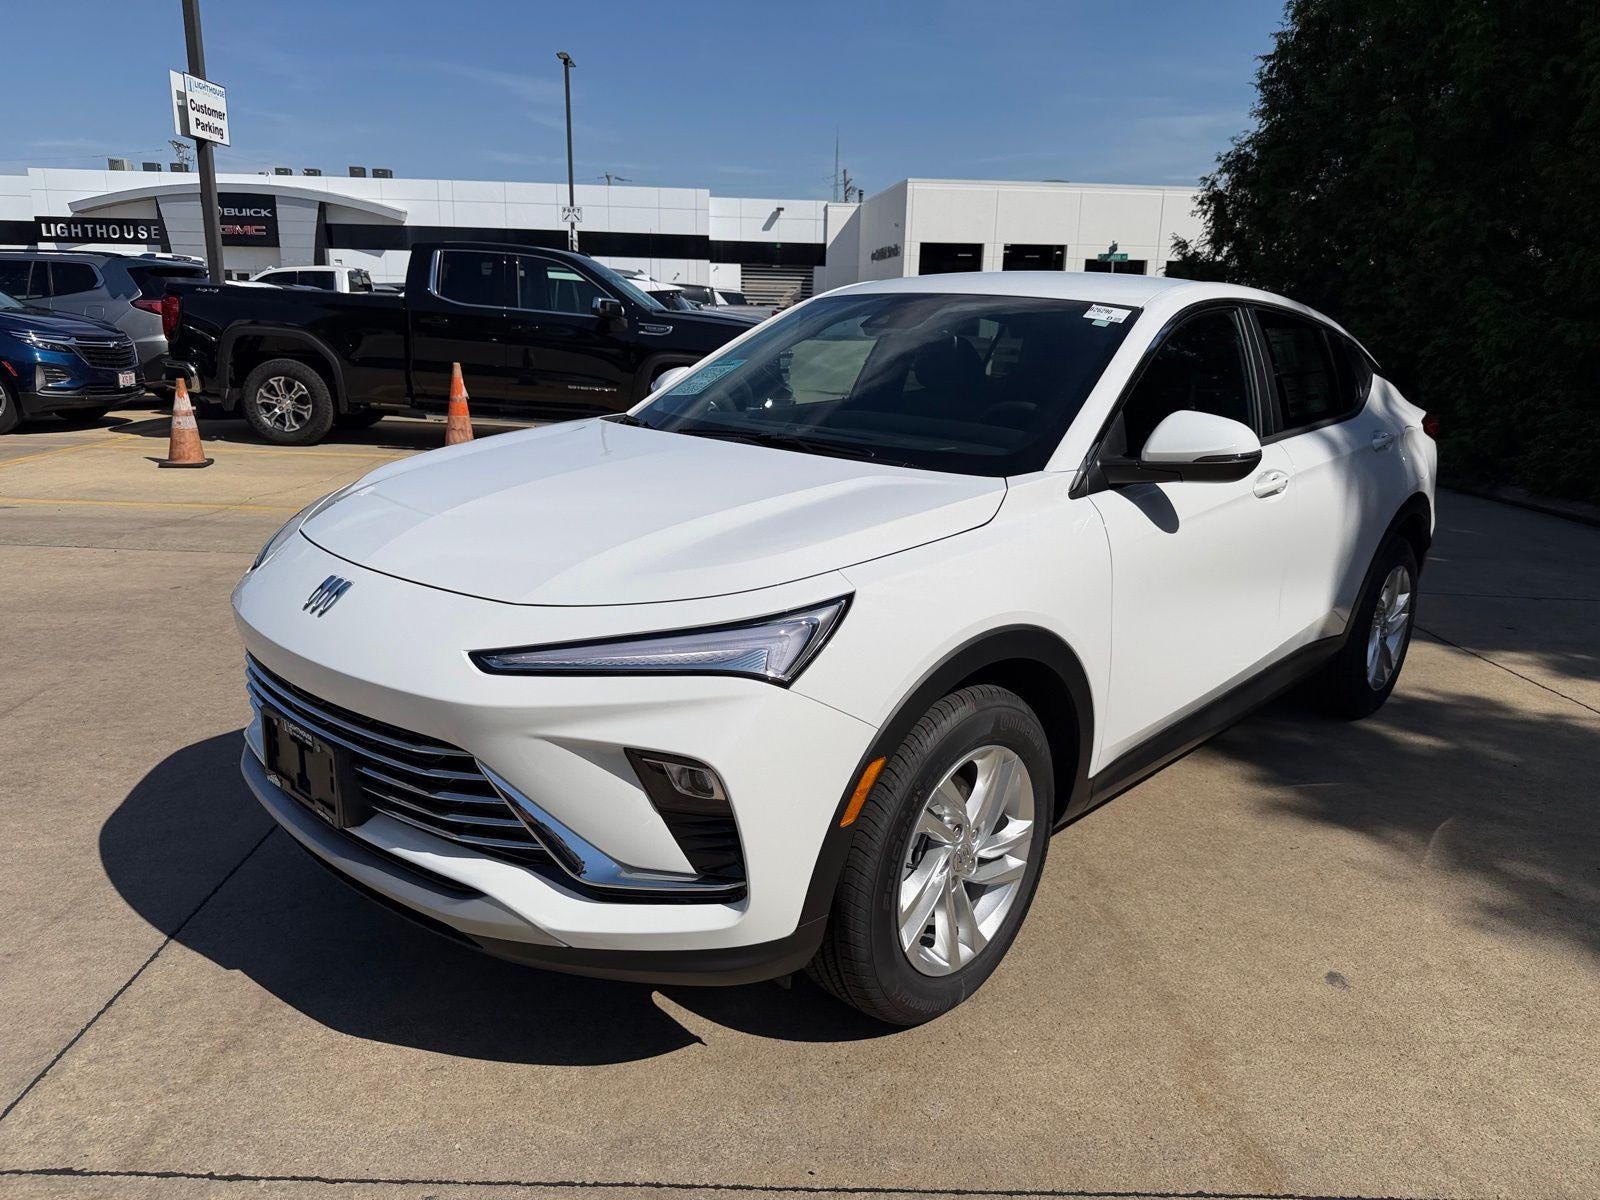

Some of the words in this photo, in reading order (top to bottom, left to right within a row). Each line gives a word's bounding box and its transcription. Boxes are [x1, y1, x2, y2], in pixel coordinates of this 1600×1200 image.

[189, 98, 225, 121] Customer
[195, 117, 224, 139] Parking
[223, 207, 273, 217] BUICK
[41, 223, 160, 239] LIGHTHOUSE
[220, 224, 266, 235] GMC
